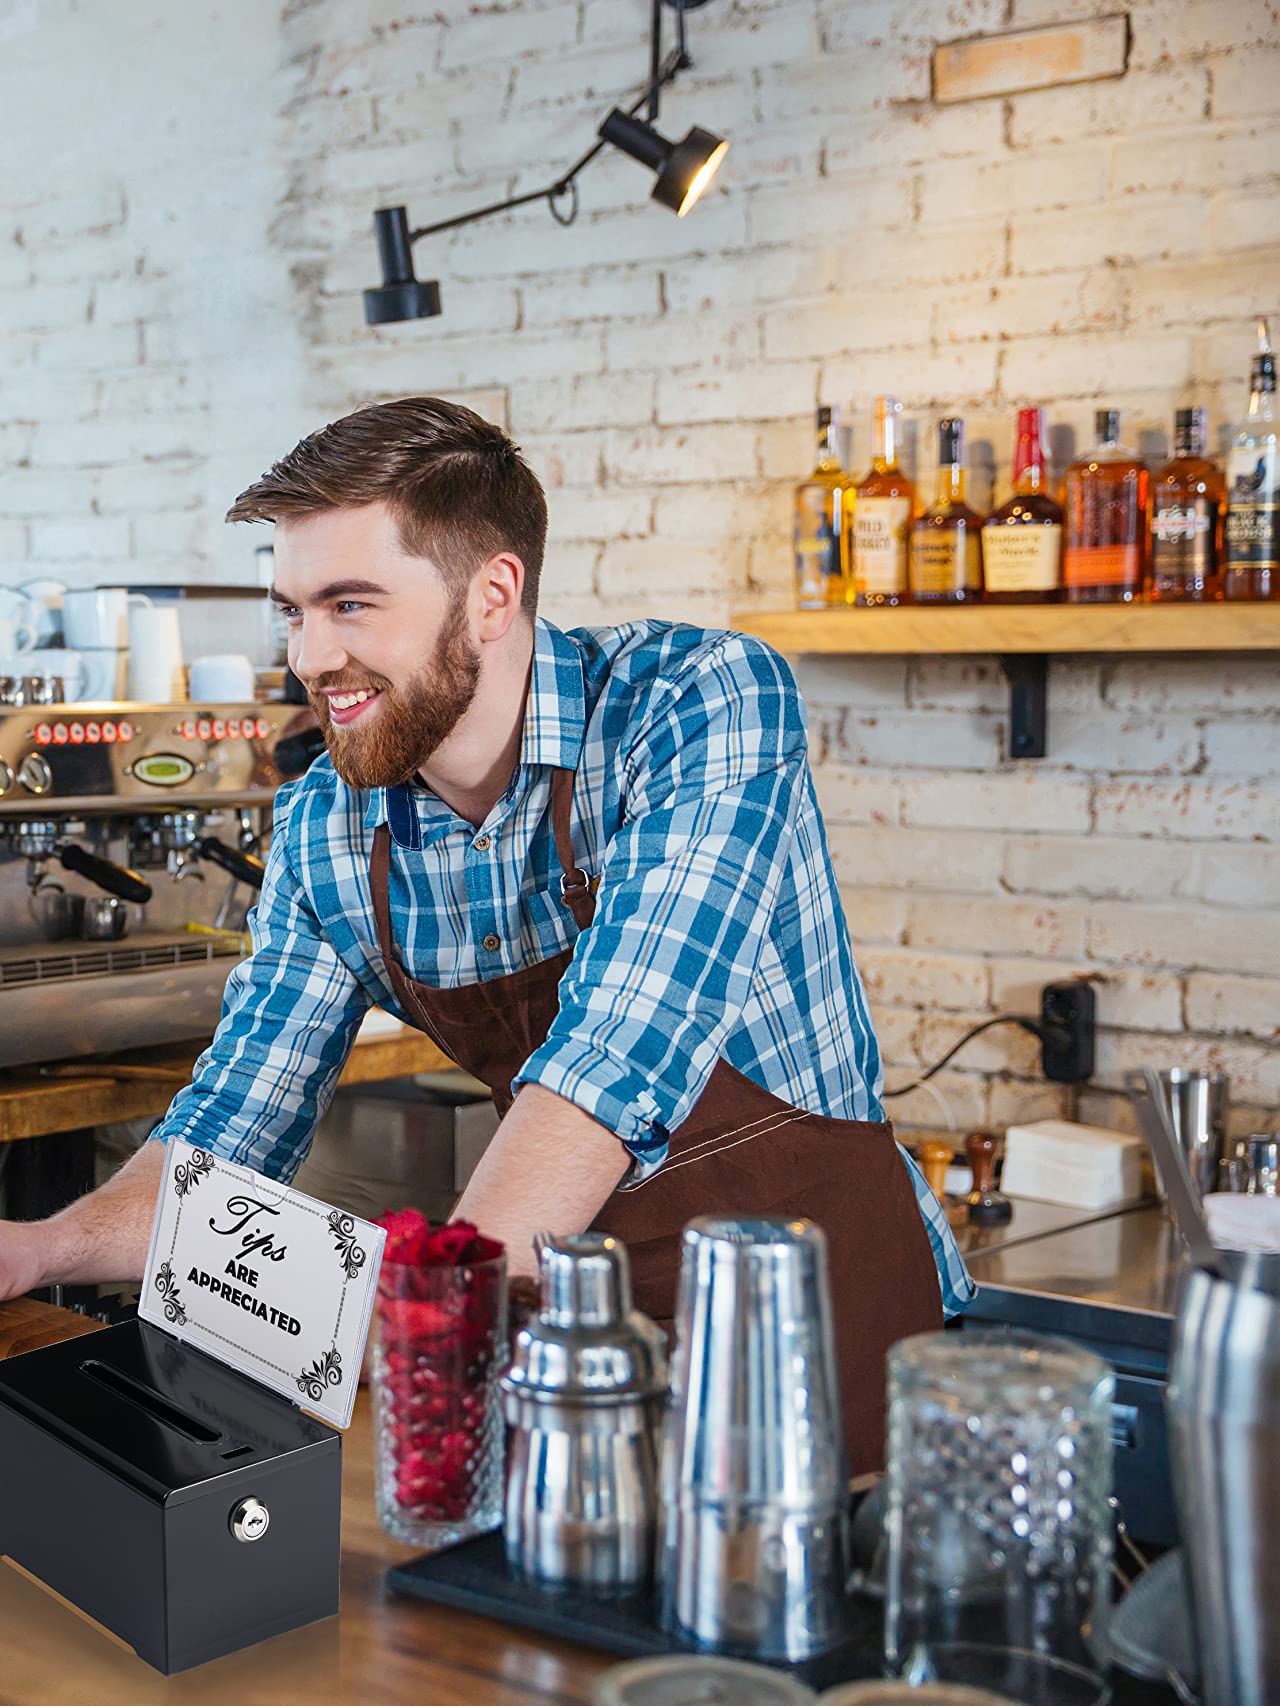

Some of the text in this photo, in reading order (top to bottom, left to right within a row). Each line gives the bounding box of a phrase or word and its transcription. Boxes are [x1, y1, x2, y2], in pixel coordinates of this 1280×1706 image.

[209, 1196, 288, 1262] Tips
[187, 1267, 301, 1337] APPRECIATED
[224, 1259, 259, 1289] ARE
